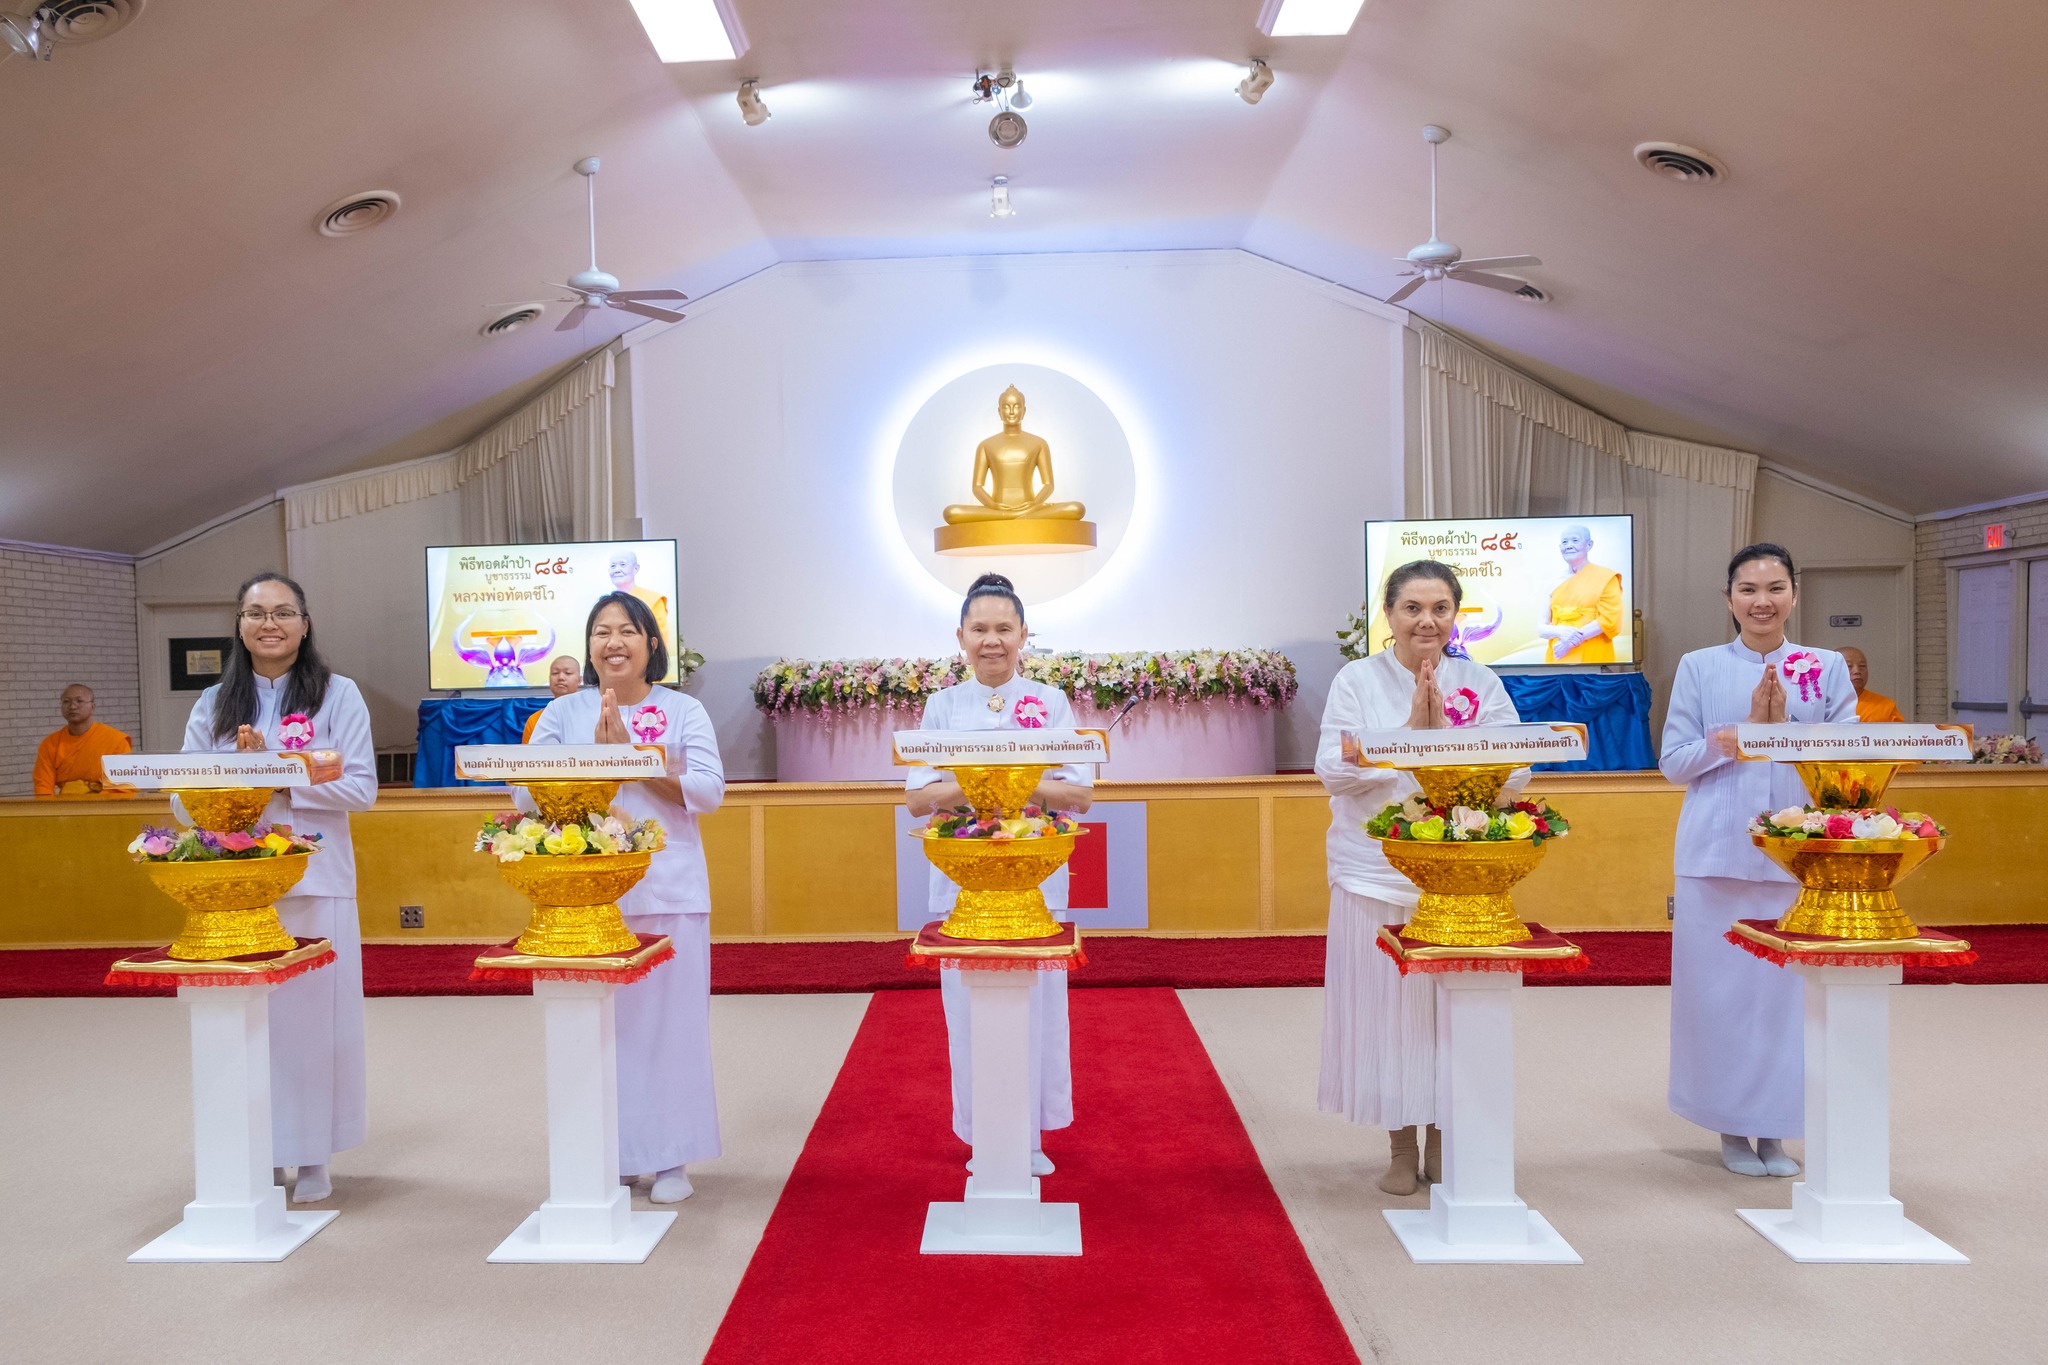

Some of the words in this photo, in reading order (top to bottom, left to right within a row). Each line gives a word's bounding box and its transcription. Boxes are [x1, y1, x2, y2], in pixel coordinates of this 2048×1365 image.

[1400, 529, 1477, 546] พิธีทอดผ้าป่า
[1987, 525, 2003, 549] EXIT
[459, 555, 531, 571] พิธีทอดผ้าป่า
[453, 585, 555, 603] หลวงพ่อทัตตชีโว
[1018, 739, 1101, 751] หลวงพ่อทัตตชีโว
[1491, 736, 1579, 750] หลวงพ่อทัตตชีโว
[1872, 734, 1965, 747] หลวงพ่อทัตตชีโว
[578, 755, 659, 767] หลวงพ่อทัตตชีโว
[223, 763, 304, 775] หลวงพ่อทัตตชีโว
